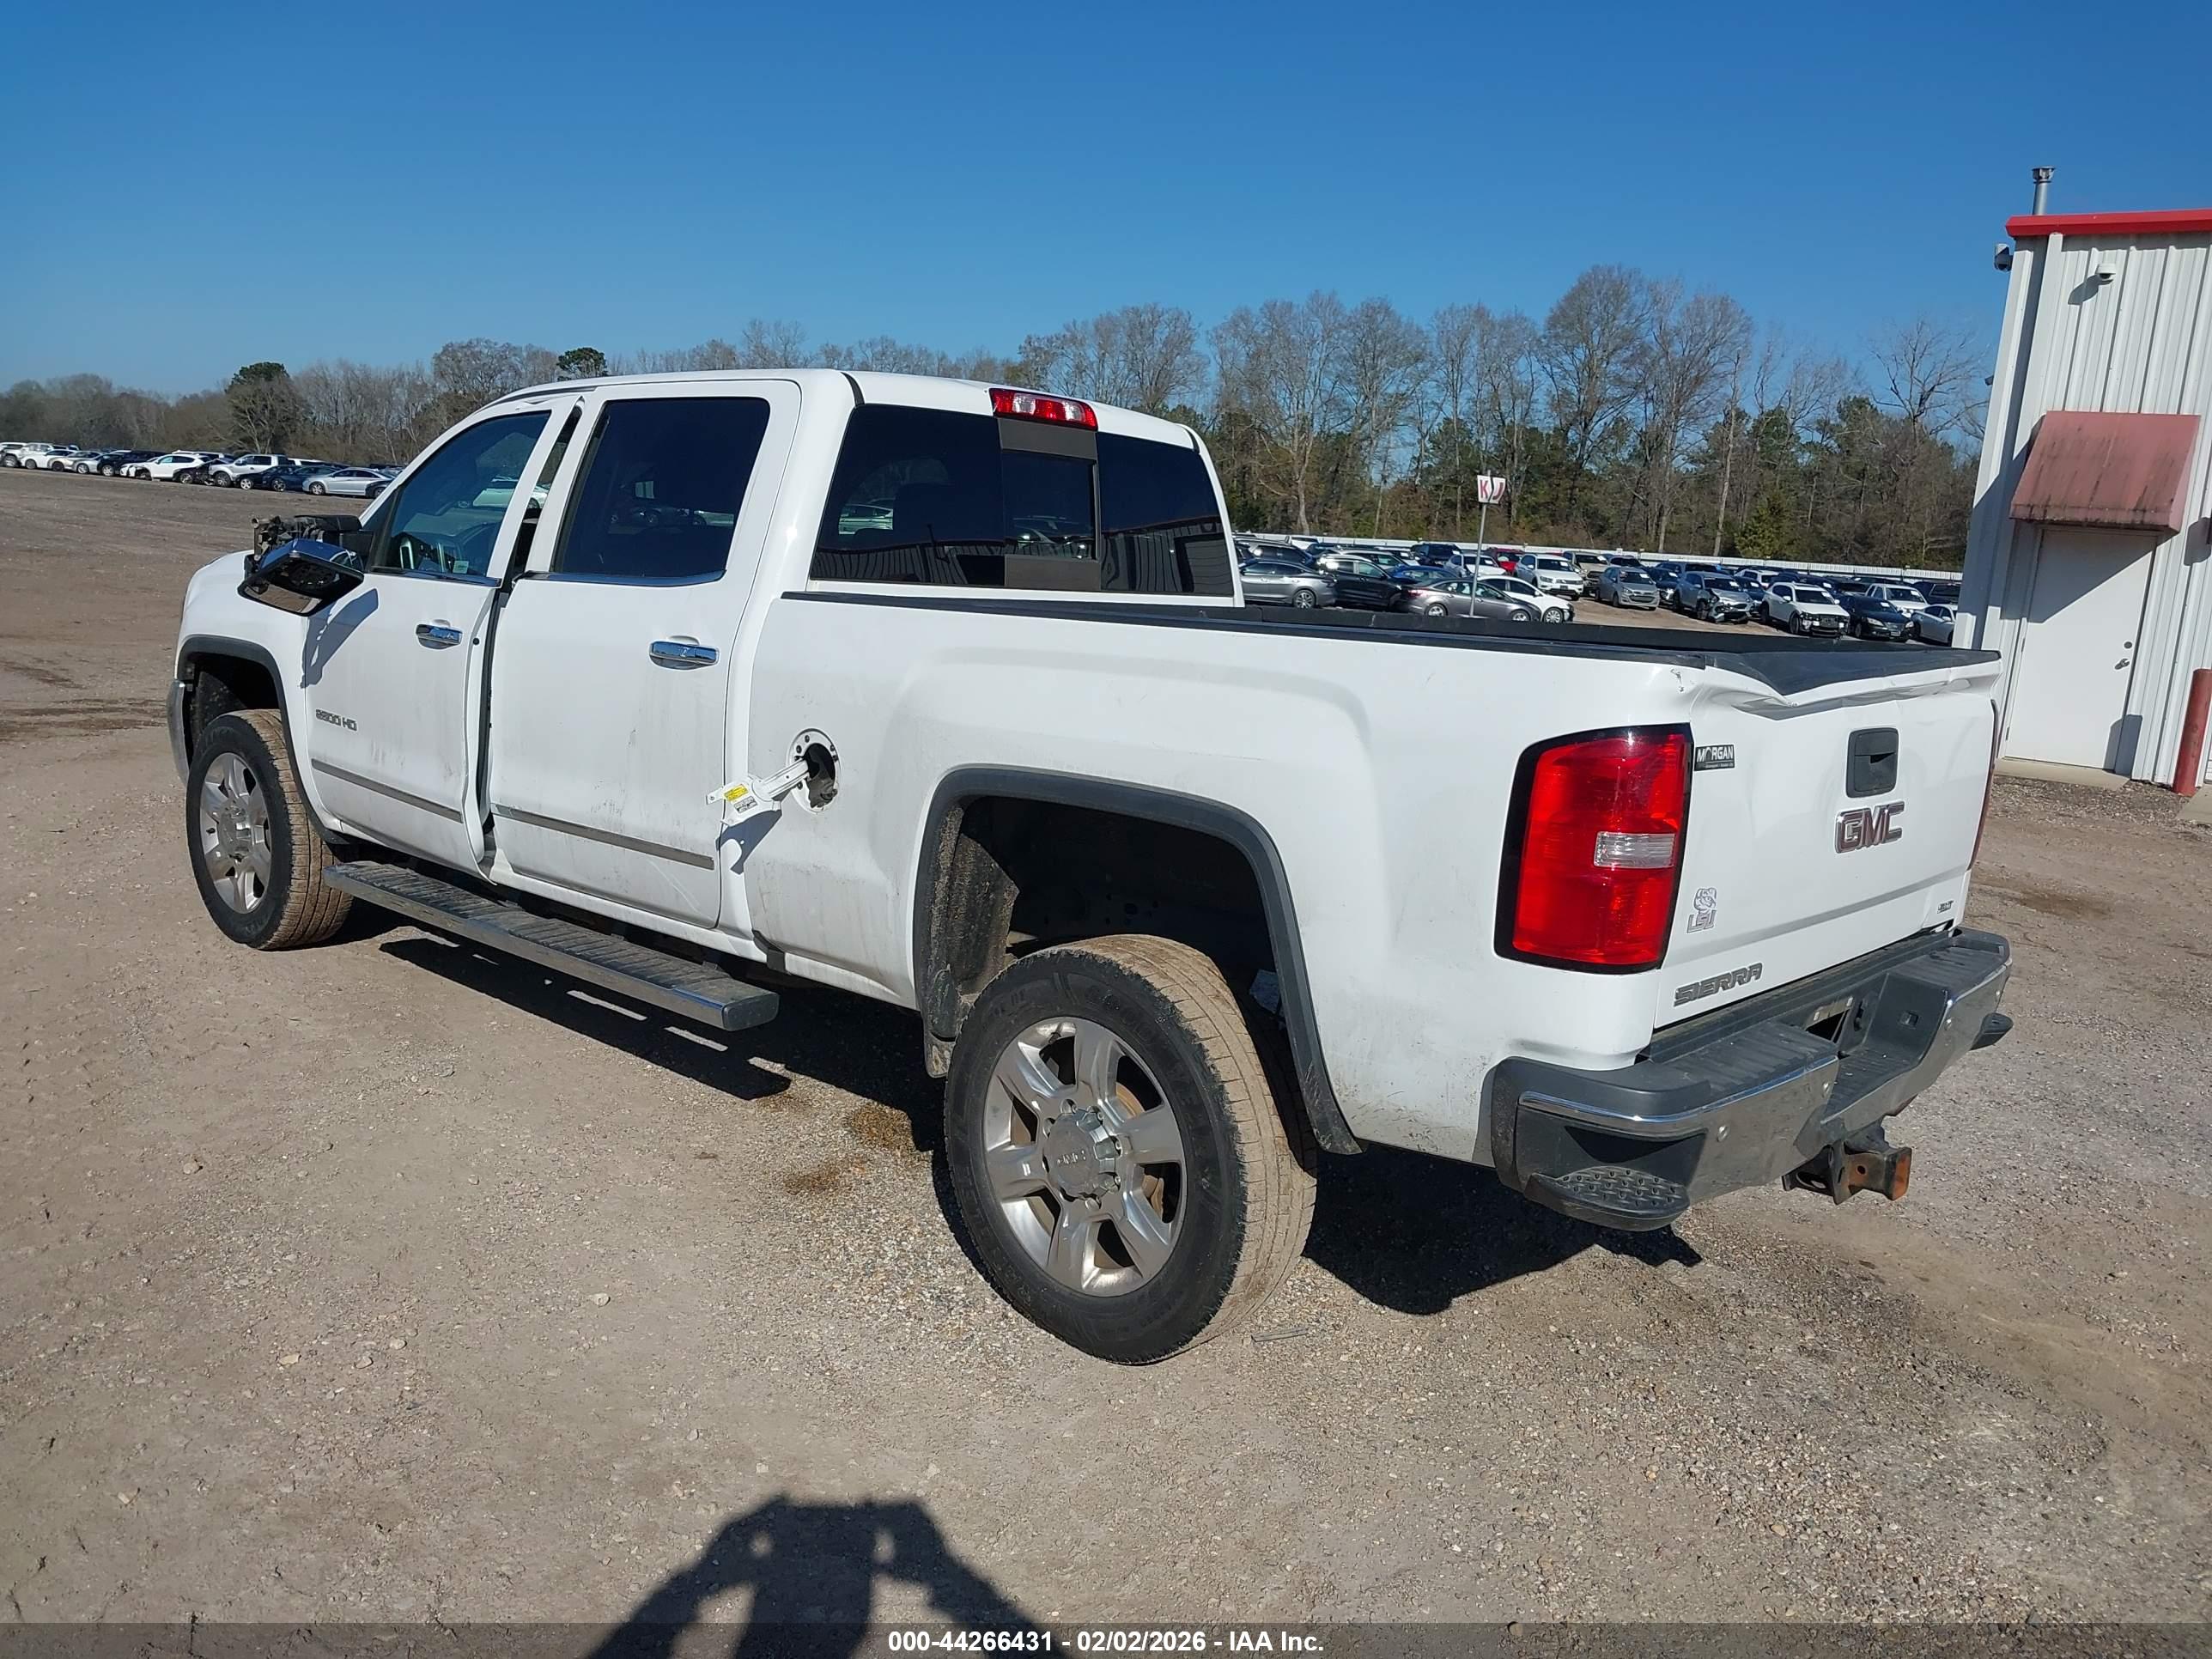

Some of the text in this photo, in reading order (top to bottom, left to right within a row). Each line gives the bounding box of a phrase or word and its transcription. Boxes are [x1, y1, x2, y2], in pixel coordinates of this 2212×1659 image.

[1480, 479, 1504, 501] K J
[342, 717, 357, 732] HD
[1696, 745, 1734, 763] MORGAN
[1835, 800, 1905, 854] GMC
[1686, 909, 1717, 933] LSU
[1673, 962, 1763, 1007] SIERRA
